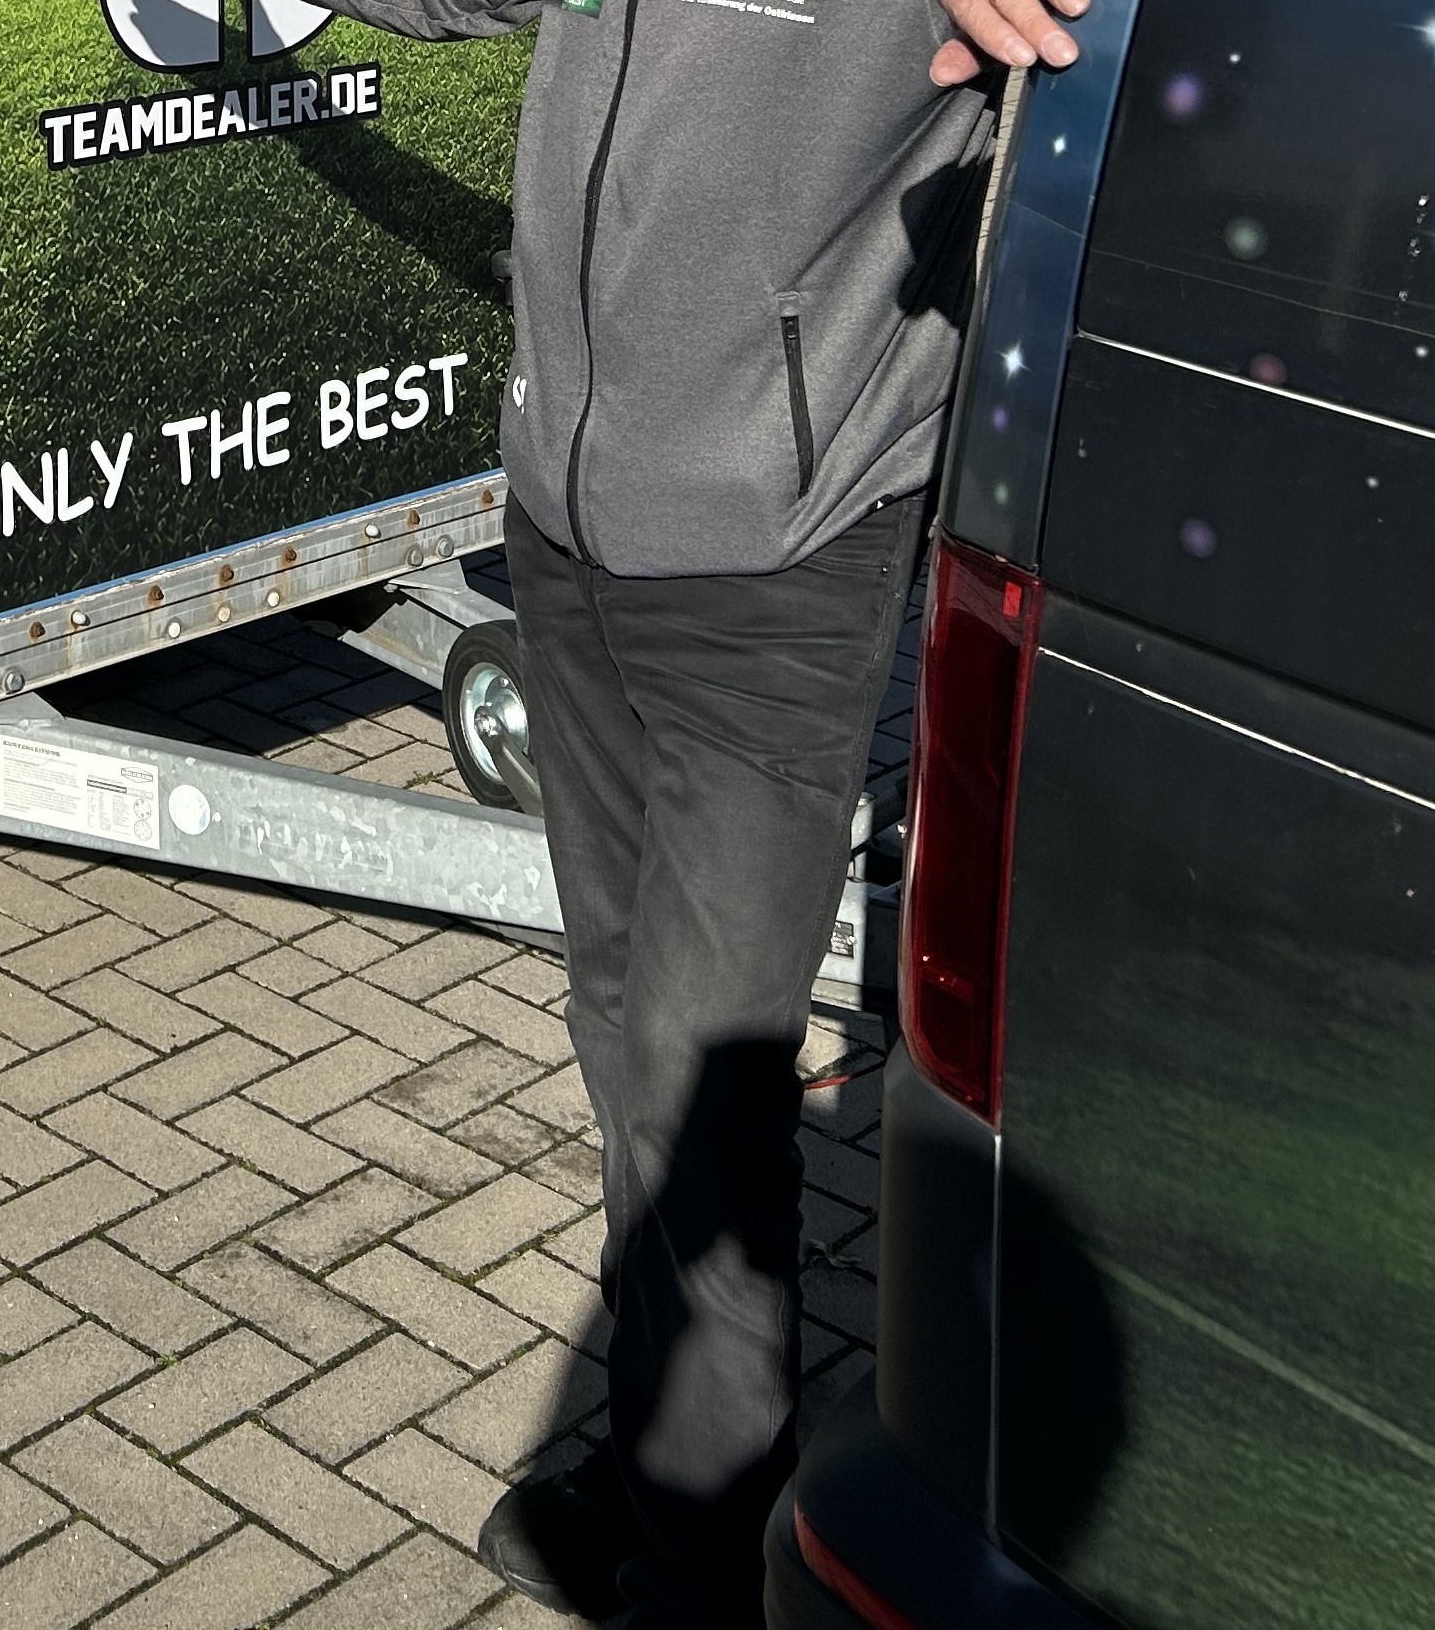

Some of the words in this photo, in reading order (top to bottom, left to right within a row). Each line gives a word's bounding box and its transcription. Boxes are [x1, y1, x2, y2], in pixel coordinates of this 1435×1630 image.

[43, 66, 380, 166] TEAMDEALER.DE
[162, 390, 292, 486] THE
[320, 353, 468, 450] BEST
